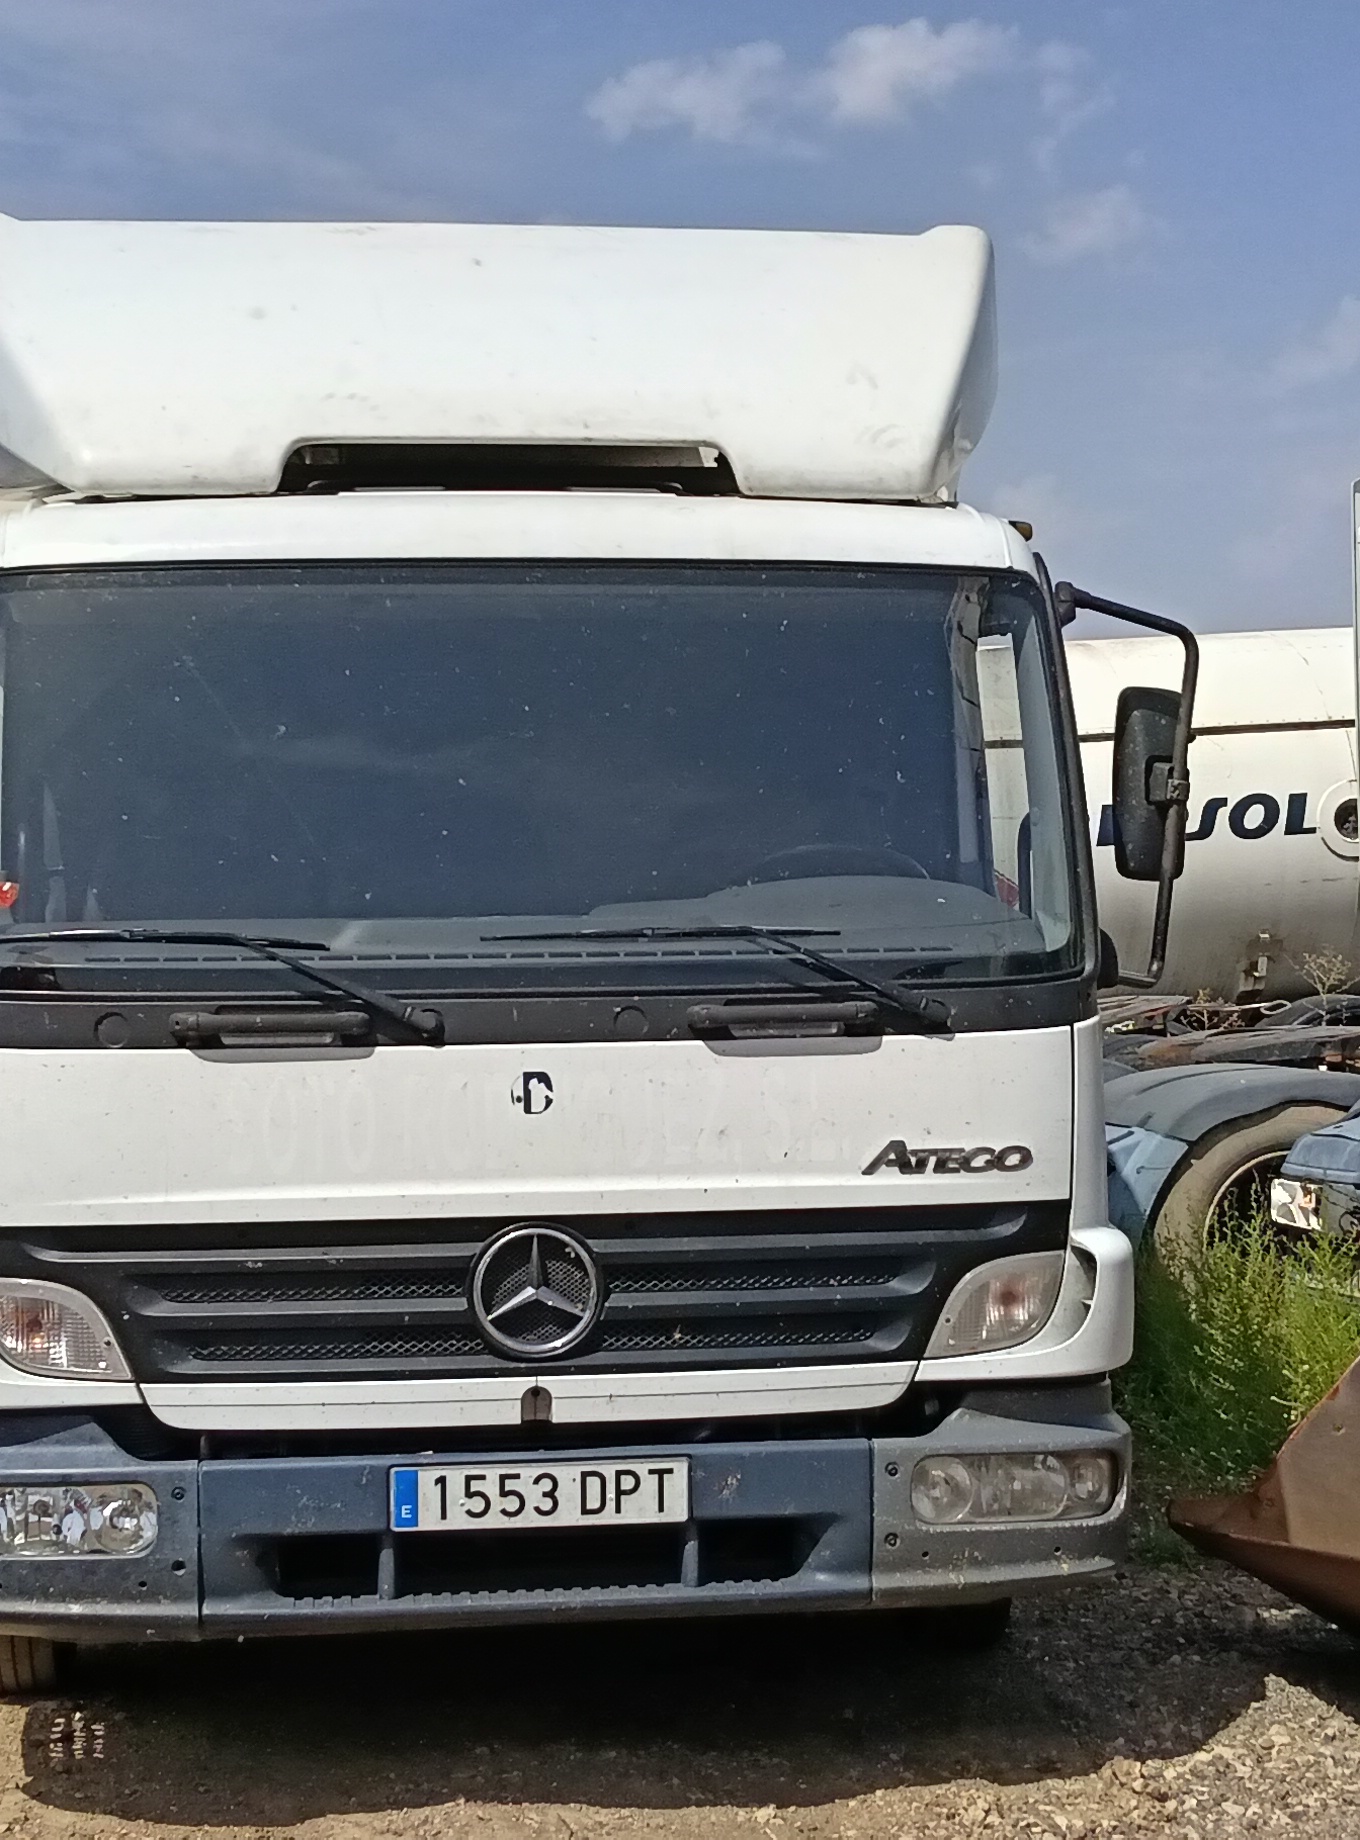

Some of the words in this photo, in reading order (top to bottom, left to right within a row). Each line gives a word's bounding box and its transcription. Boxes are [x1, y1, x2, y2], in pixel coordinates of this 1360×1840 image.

[401, 1505, 412, 1518] E
[434, 1472, 559, 1520] 1553
[580, 1468, 674, 1515] DPT
